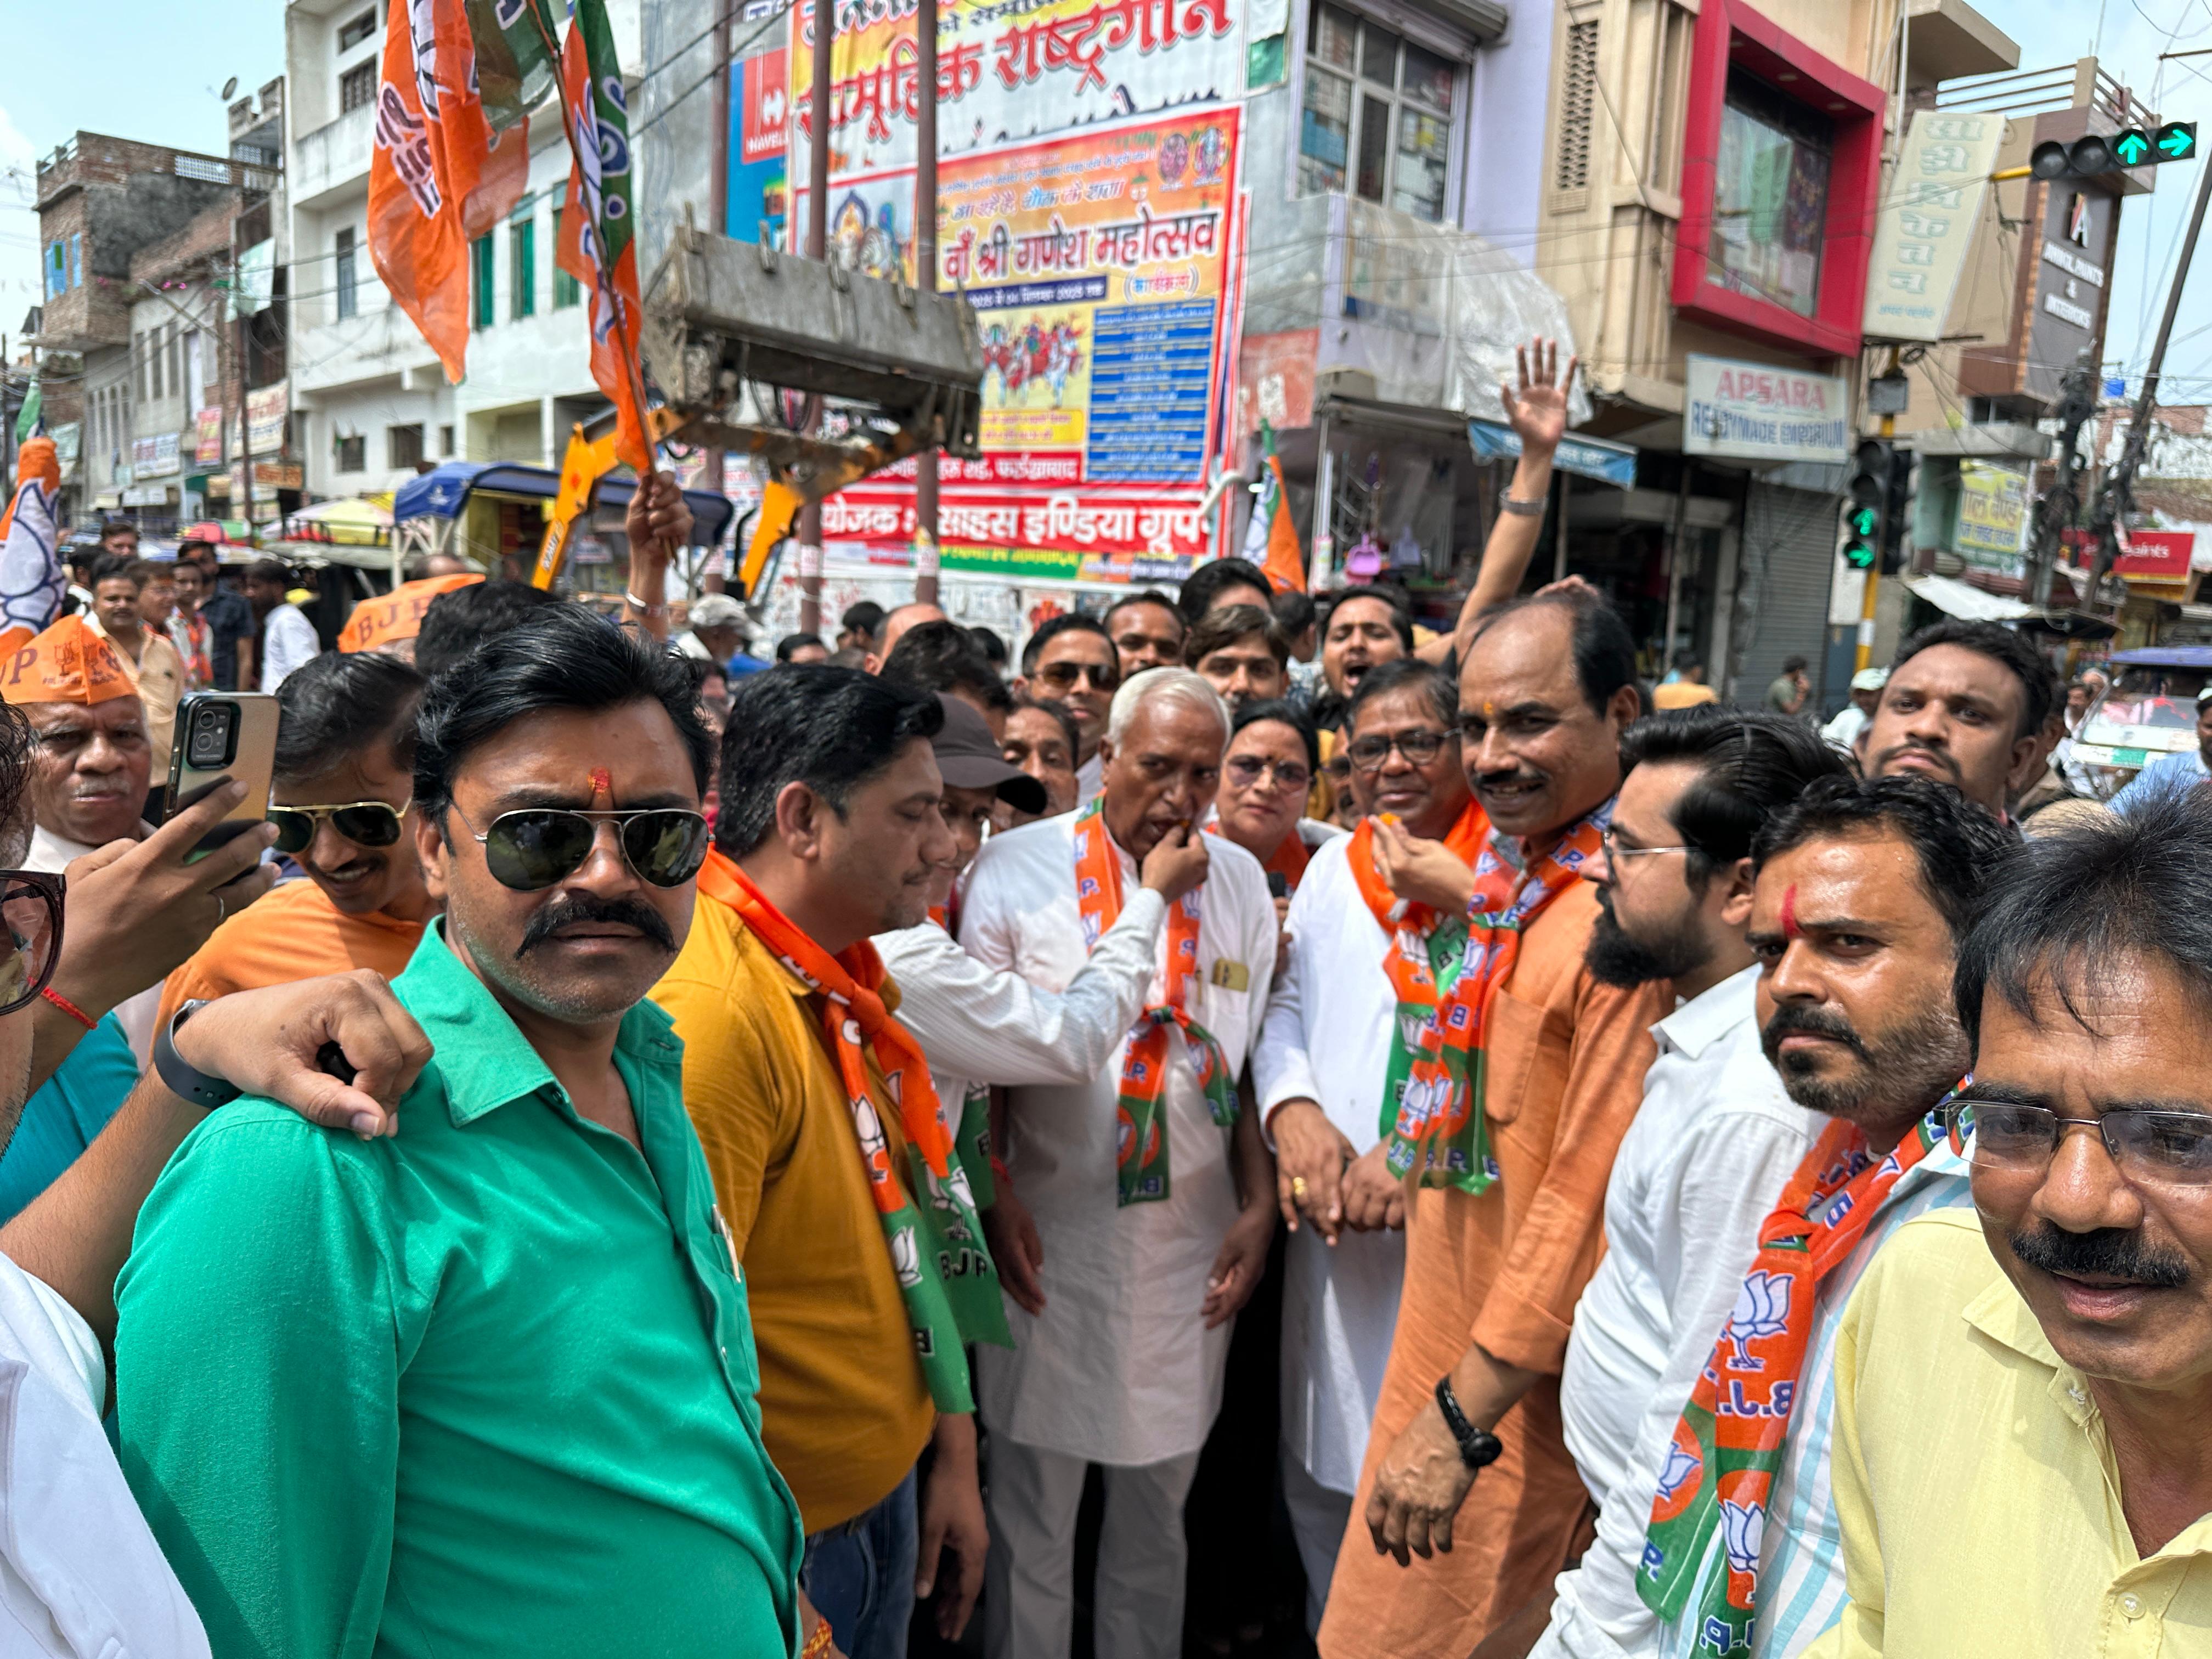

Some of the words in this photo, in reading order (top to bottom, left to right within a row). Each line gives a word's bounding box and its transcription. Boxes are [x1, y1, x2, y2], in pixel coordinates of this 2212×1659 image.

[1015, 214, 1089, 270] गणेश
[1097, 205, 1217, 266] महोत्सव
[1716, 370, 1826, 411] APSARA
[1780, 417, 1846, 450] EMPORIUM
[939, 504, 1019, 540] साहस
[1023, 493, 1136, 545] इण्डिया
